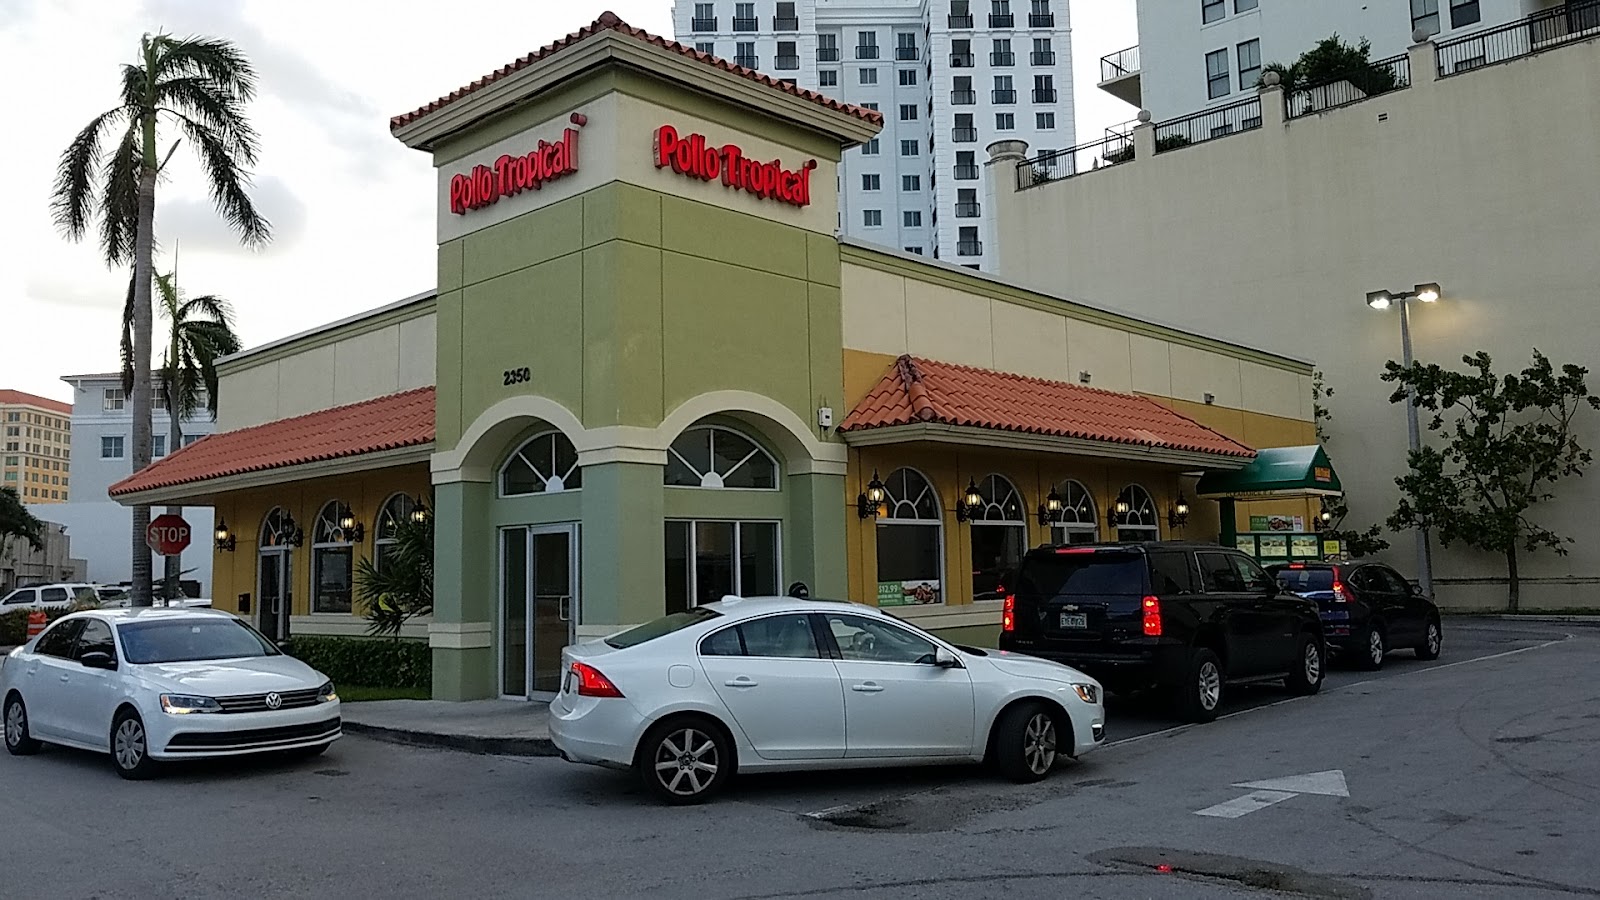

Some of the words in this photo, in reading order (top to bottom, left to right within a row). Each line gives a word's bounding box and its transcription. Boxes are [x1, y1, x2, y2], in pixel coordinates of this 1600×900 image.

[450, 173, 500, 215] Pollo
[494, 113, 587, 198] Tropical
[653, 125, 720, 182] Pollo
[717, 145, 817, 208] Tropical
[503, 367, 531, 385] 2350
[150, 527, 189, 543] STOP
[879, 585, 898, 593] $12.99
